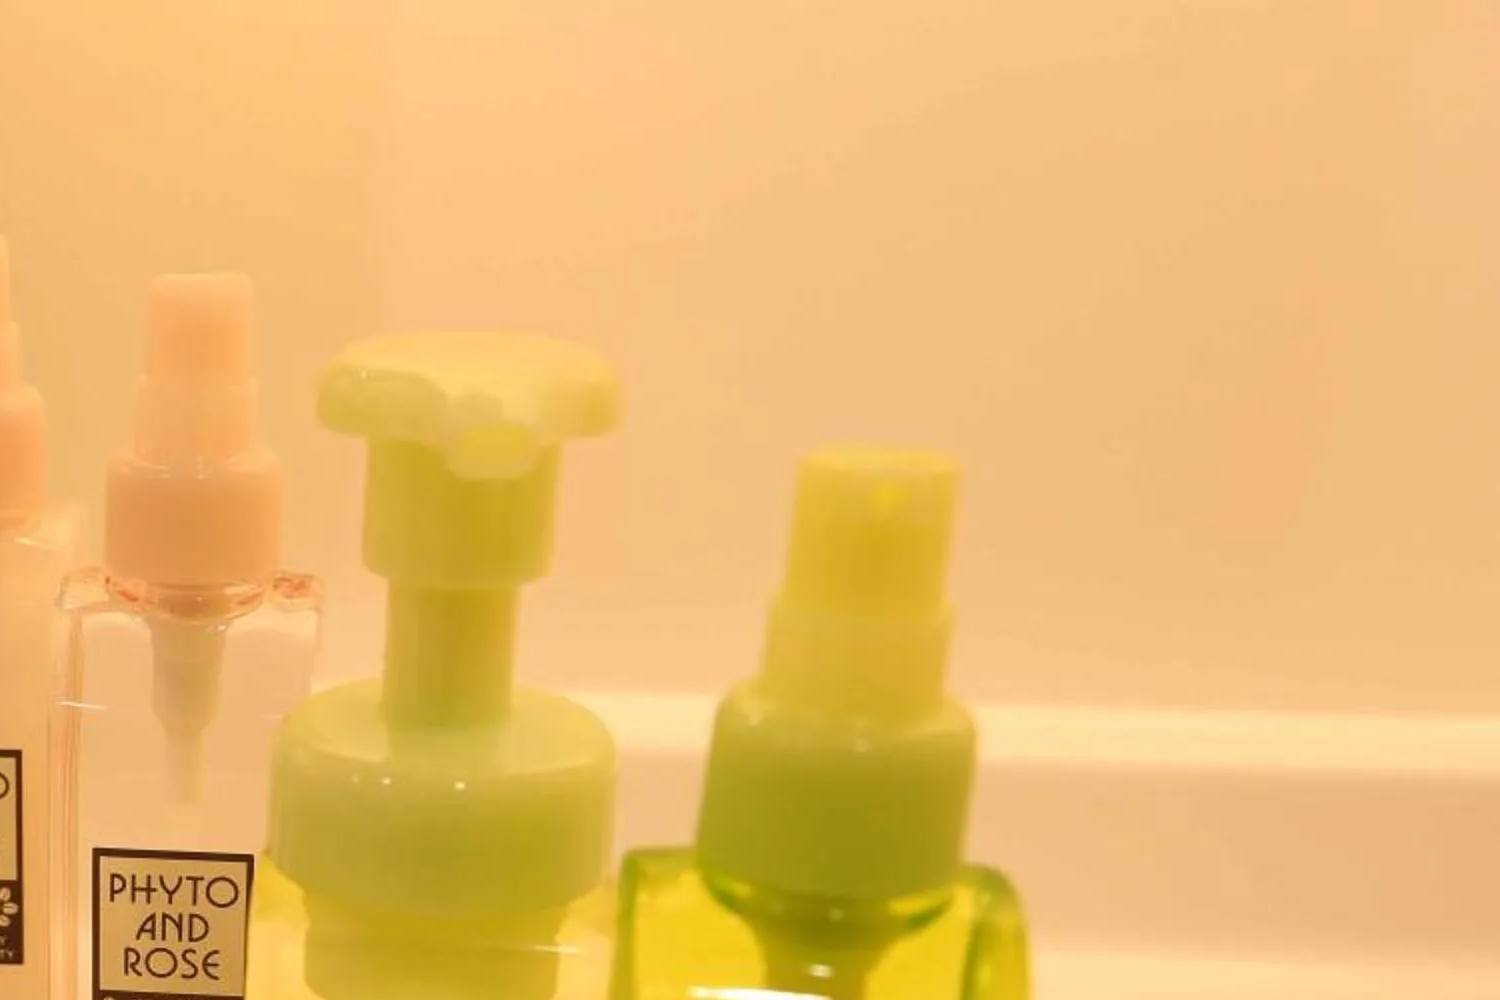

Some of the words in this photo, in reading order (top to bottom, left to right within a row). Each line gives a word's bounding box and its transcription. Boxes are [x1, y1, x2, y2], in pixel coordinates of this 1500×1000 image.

[109, 873, 239, 908] PHYTO
[136, 912, 209, 942] AND
[124, 947, 221, 981] ROSE
